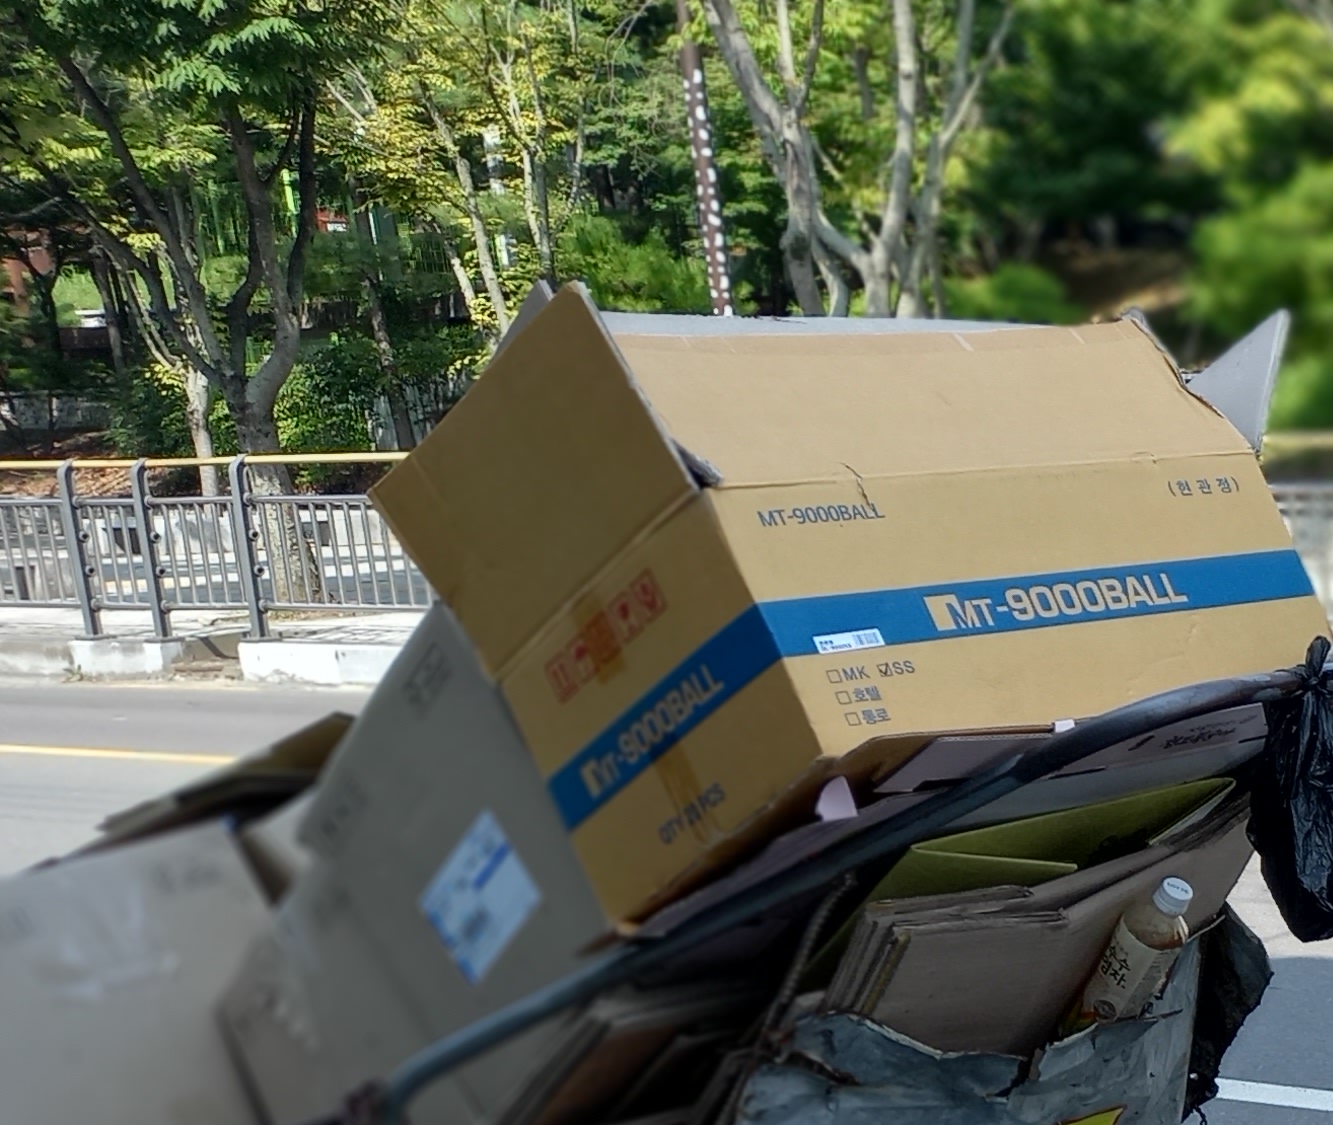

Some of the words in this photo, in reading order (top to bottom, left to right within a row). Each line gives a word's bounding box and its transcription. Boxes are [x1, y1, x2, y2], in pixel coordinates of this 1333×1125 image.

[756, 502, 886, 528] MT-9000BALL
[922, 572, 1189, 632] MT-9000BALL
[841, 665, 870, 681] MK
[892, 660, 916, 676] SS
[852, 686, 882, 703] 호텔
